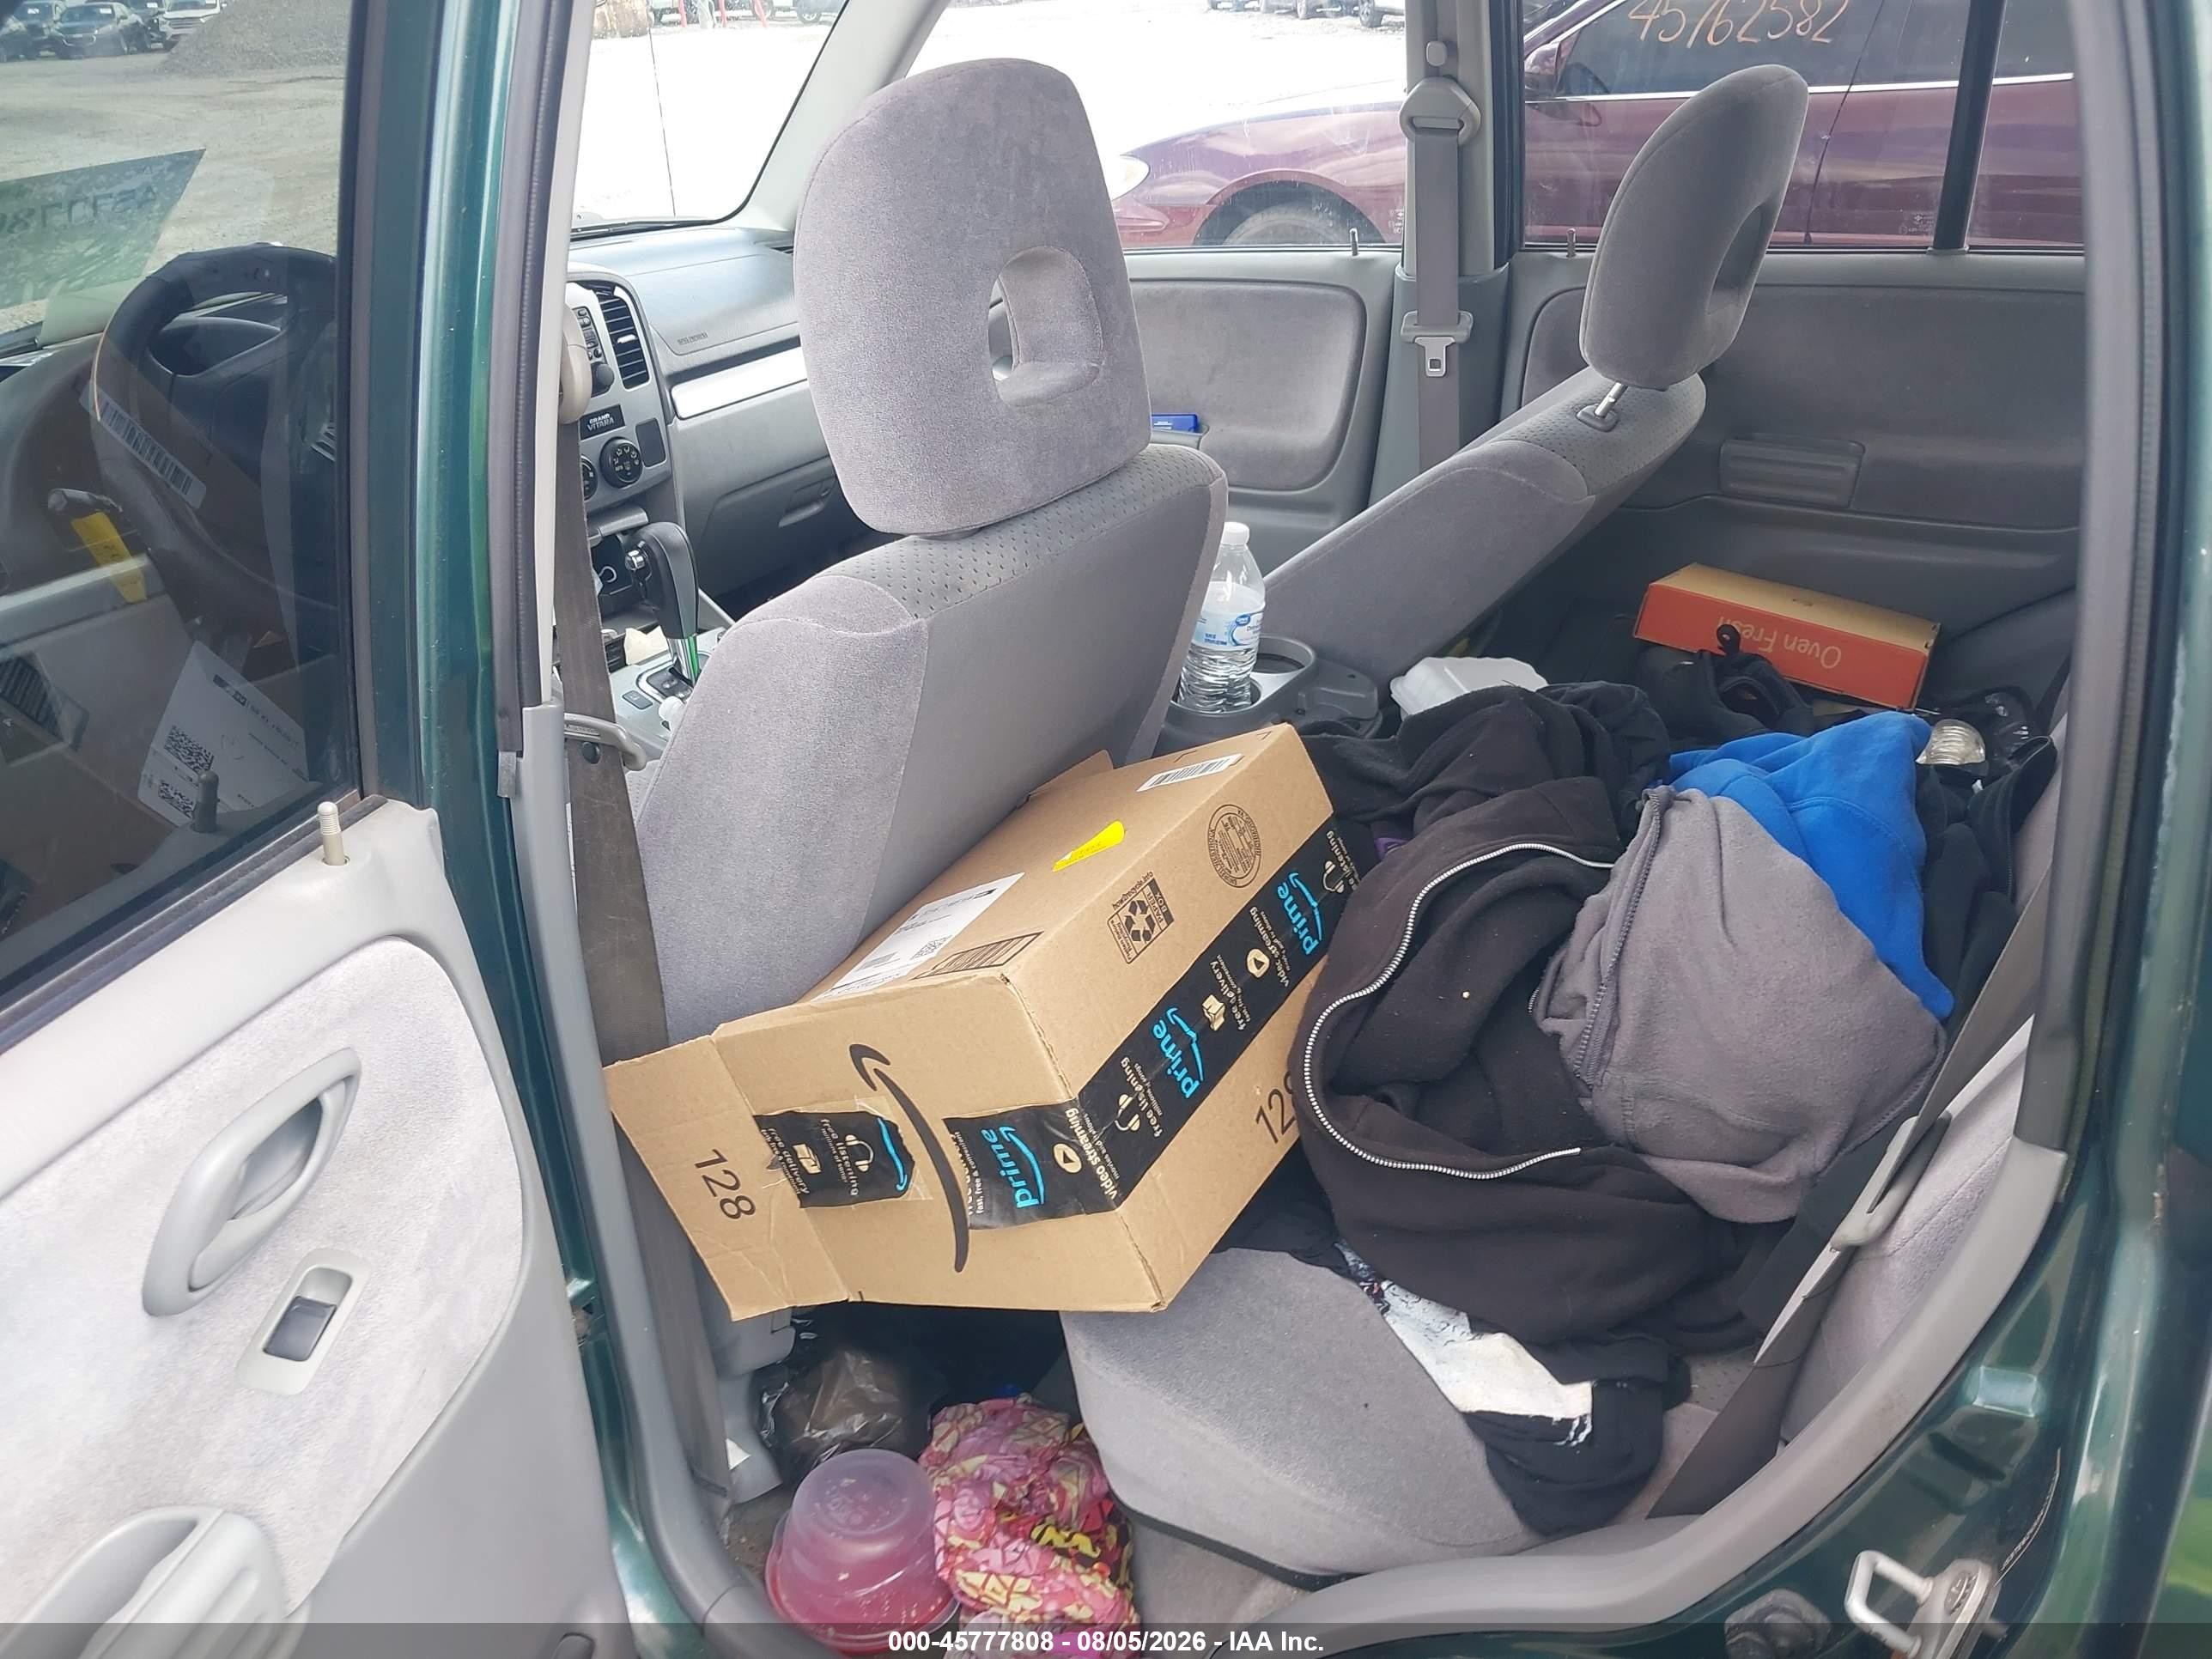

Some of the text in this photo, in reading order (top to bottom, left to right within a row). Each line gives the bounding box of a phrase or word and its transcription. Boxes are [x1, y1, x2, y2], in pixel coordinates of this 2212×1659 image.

[586, 417, 614, 431] VITARA
[589, 413, 610, 424] GRAND
[1784, 632, 1842, 669] Oven
[1146, 892, 1164, 924] PAPER
[1155, 891, 1168, 913] BOX
[1277, 882, 1319, 955] prime
[1249, 906, 1279, 958] streaming
[1210, 961, 1247, 1030] free delivery
[1152, 1019, 1200, 1099] prime
[1146, 1109, 1163, 1138] free
[768, 1127, 811, 1194] free delivery
[820, 1119, 859, 1196] free listening
[954, 1132, 976, 1169] convenient
[981, 1127, 1040, 1208] prime
[1065, 1108, 1118, 1200] video streaming
[694, 1148, 757, 1220] 128
[975, 1177, 983, 1194] free
